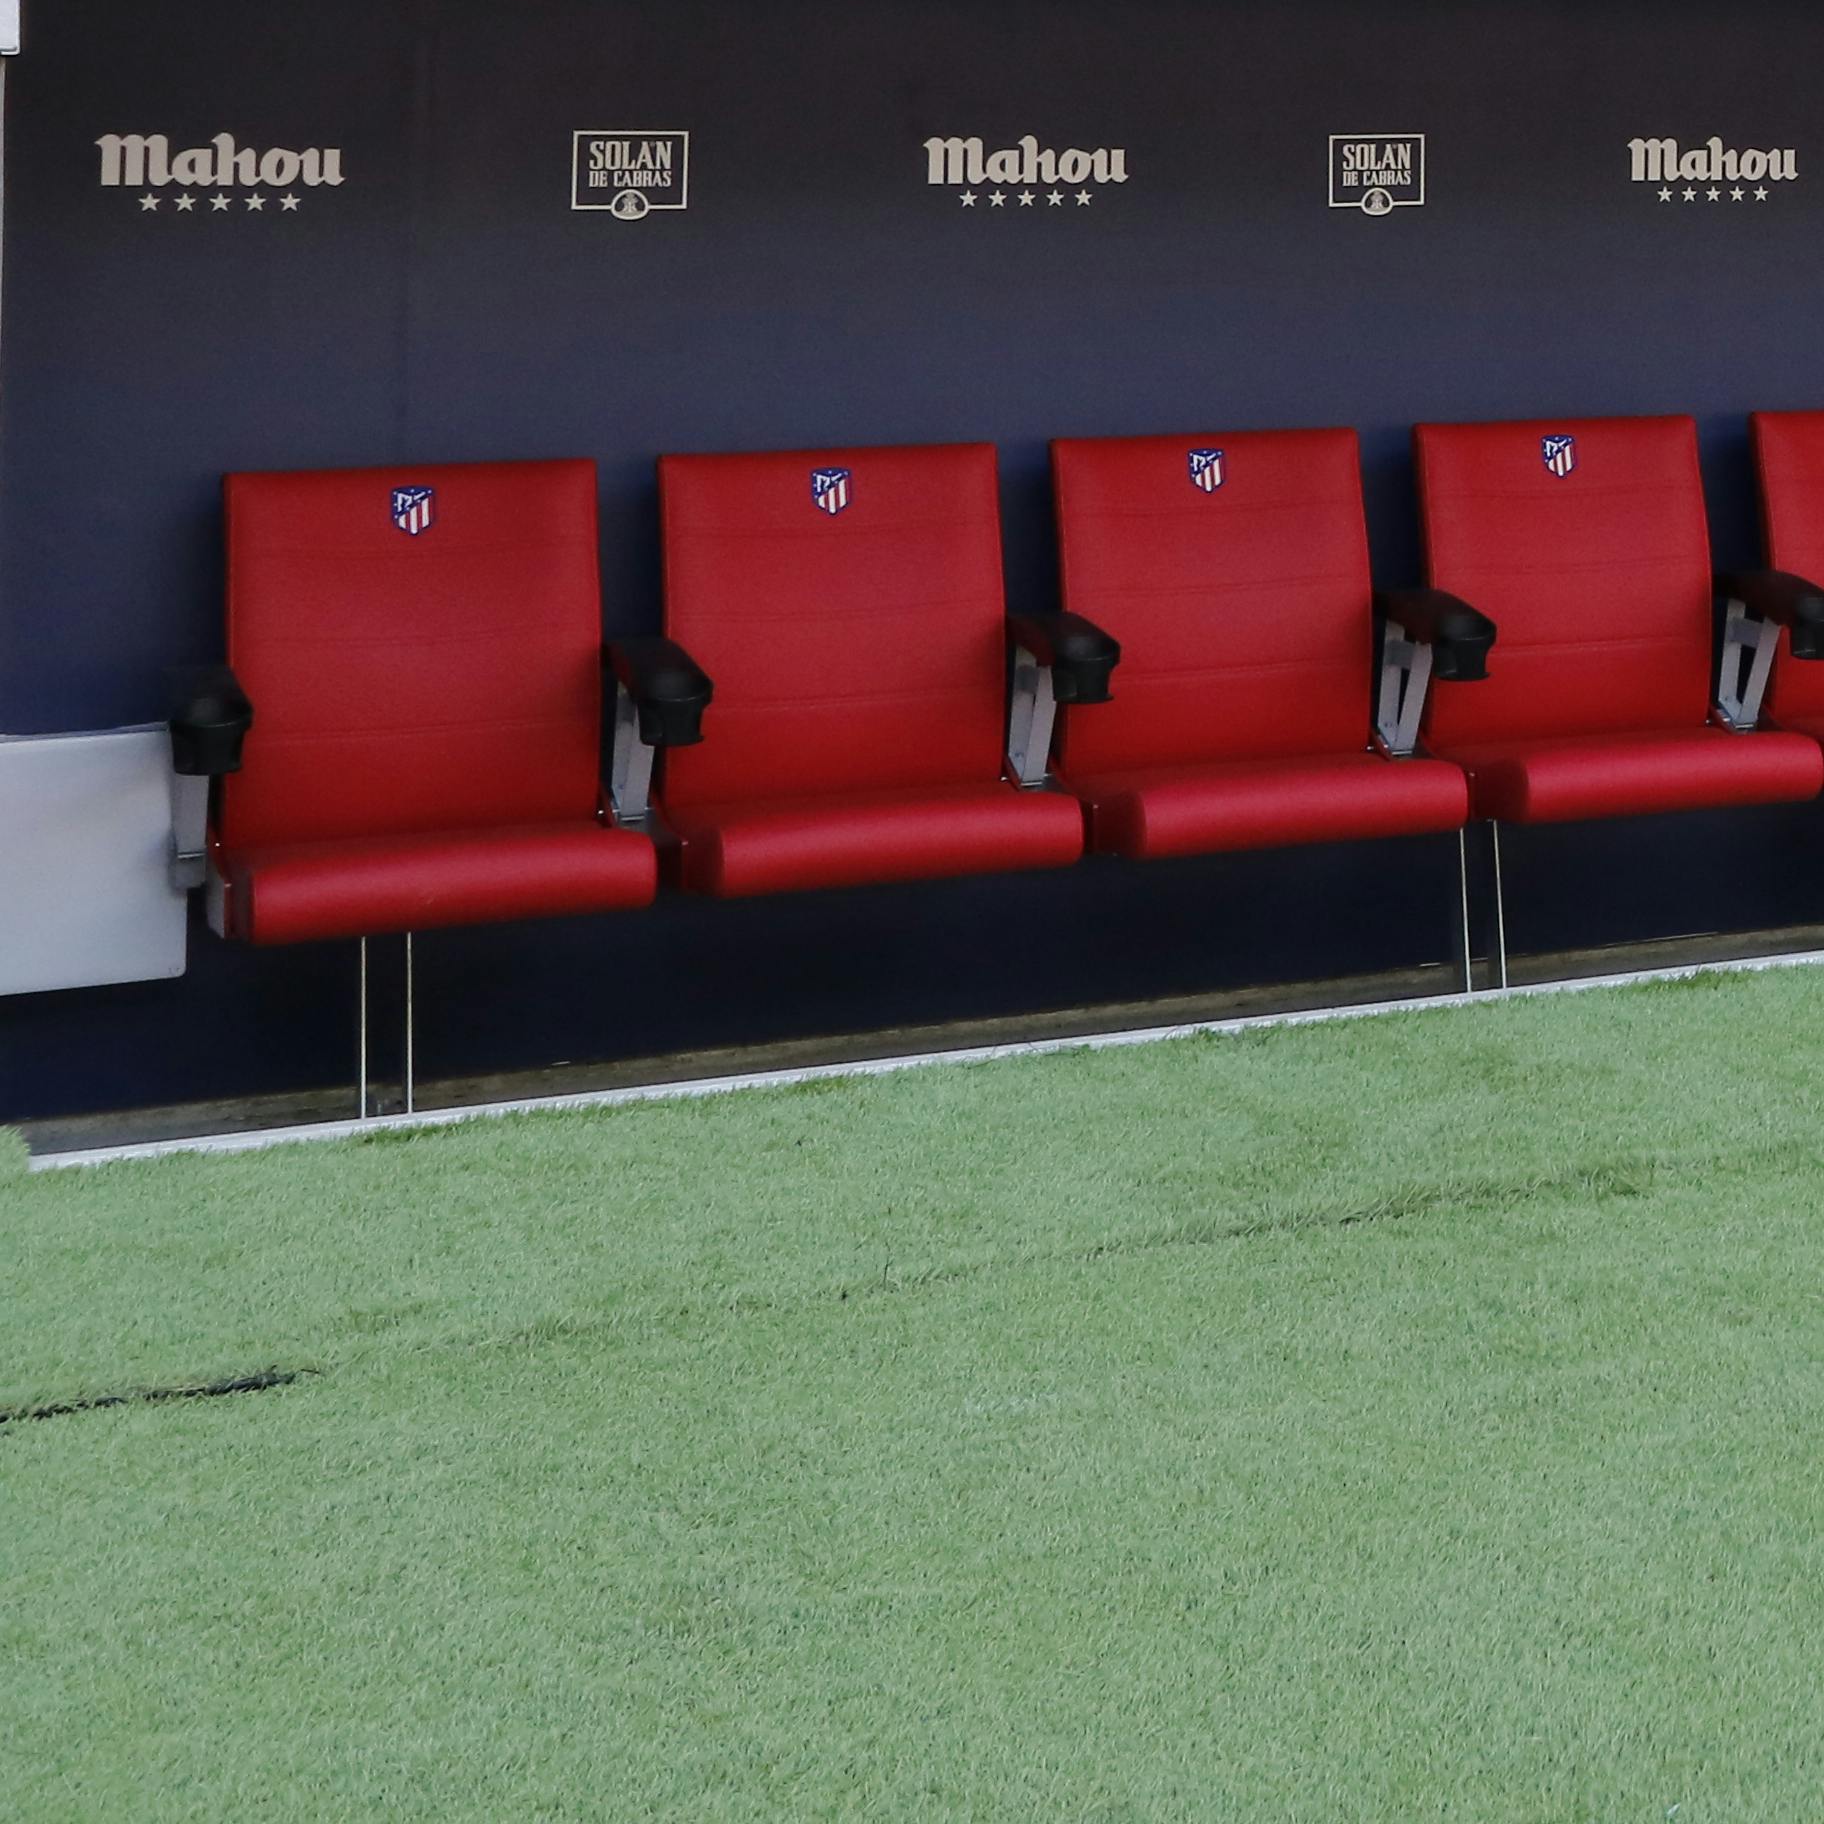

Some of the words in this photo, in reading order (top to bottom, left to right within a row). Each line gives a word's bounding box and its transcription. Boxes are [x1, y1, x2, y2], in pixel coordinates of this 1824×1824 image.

[95, 133, 345, 186] Mahou
[589, 171, 608, 187] DE
[613, 170, 672, 187] CABRAS
[923, 135, 1128, 184] Mahou
[1343, 171, 1358, 186] DE
[1363, 170, 1411, 186] CABRAS
[1627, 137, 1799, 181] Mahou
